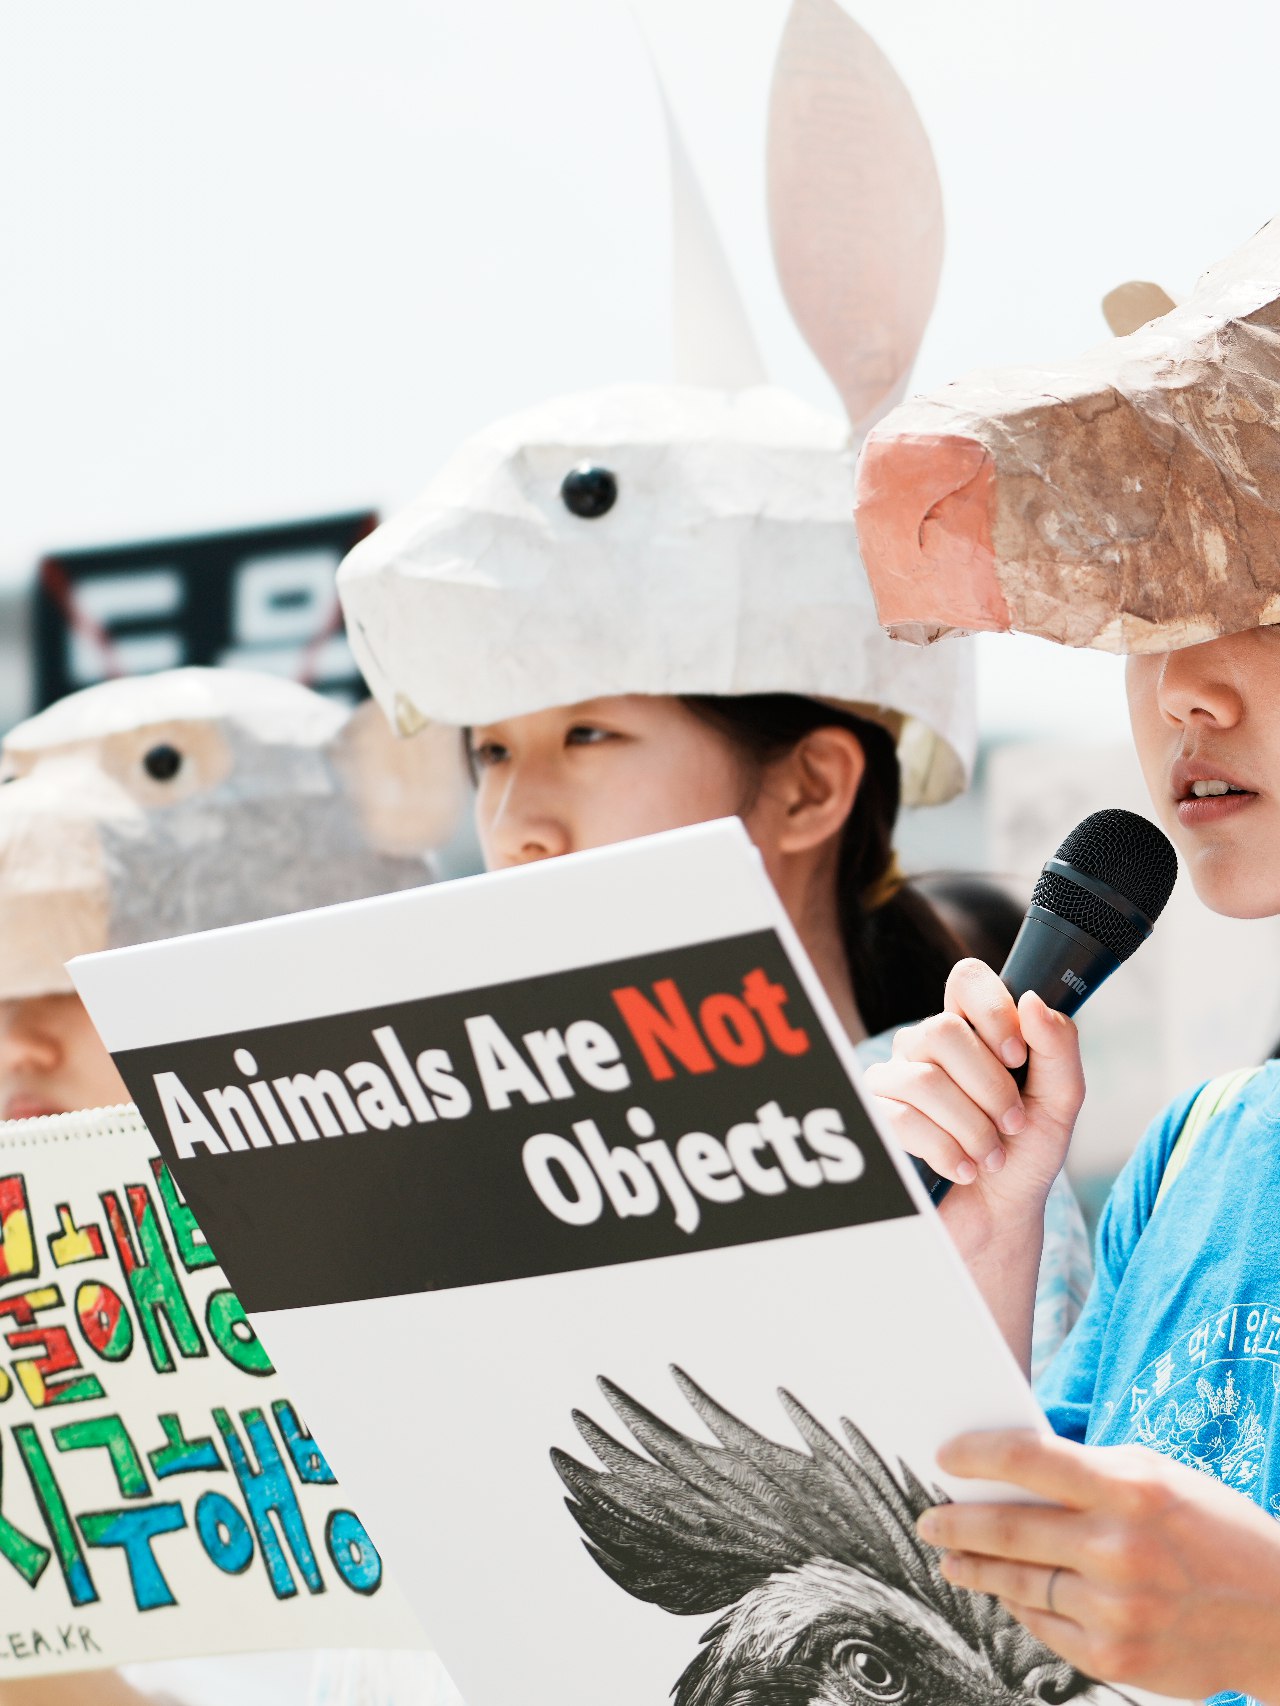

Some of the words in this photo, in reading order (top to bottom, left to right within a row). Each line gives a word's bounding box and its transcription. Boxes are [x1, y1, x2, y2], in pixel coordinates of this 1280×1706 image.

[152, 1026, 472, 1160] Animals
[464, 1013, 630, 1112] Are
[611, 967, 809, 1082] Not
[520, 1100, 864, 1234] Objects
[1188, 1308, 1238, 1364] 먹지
